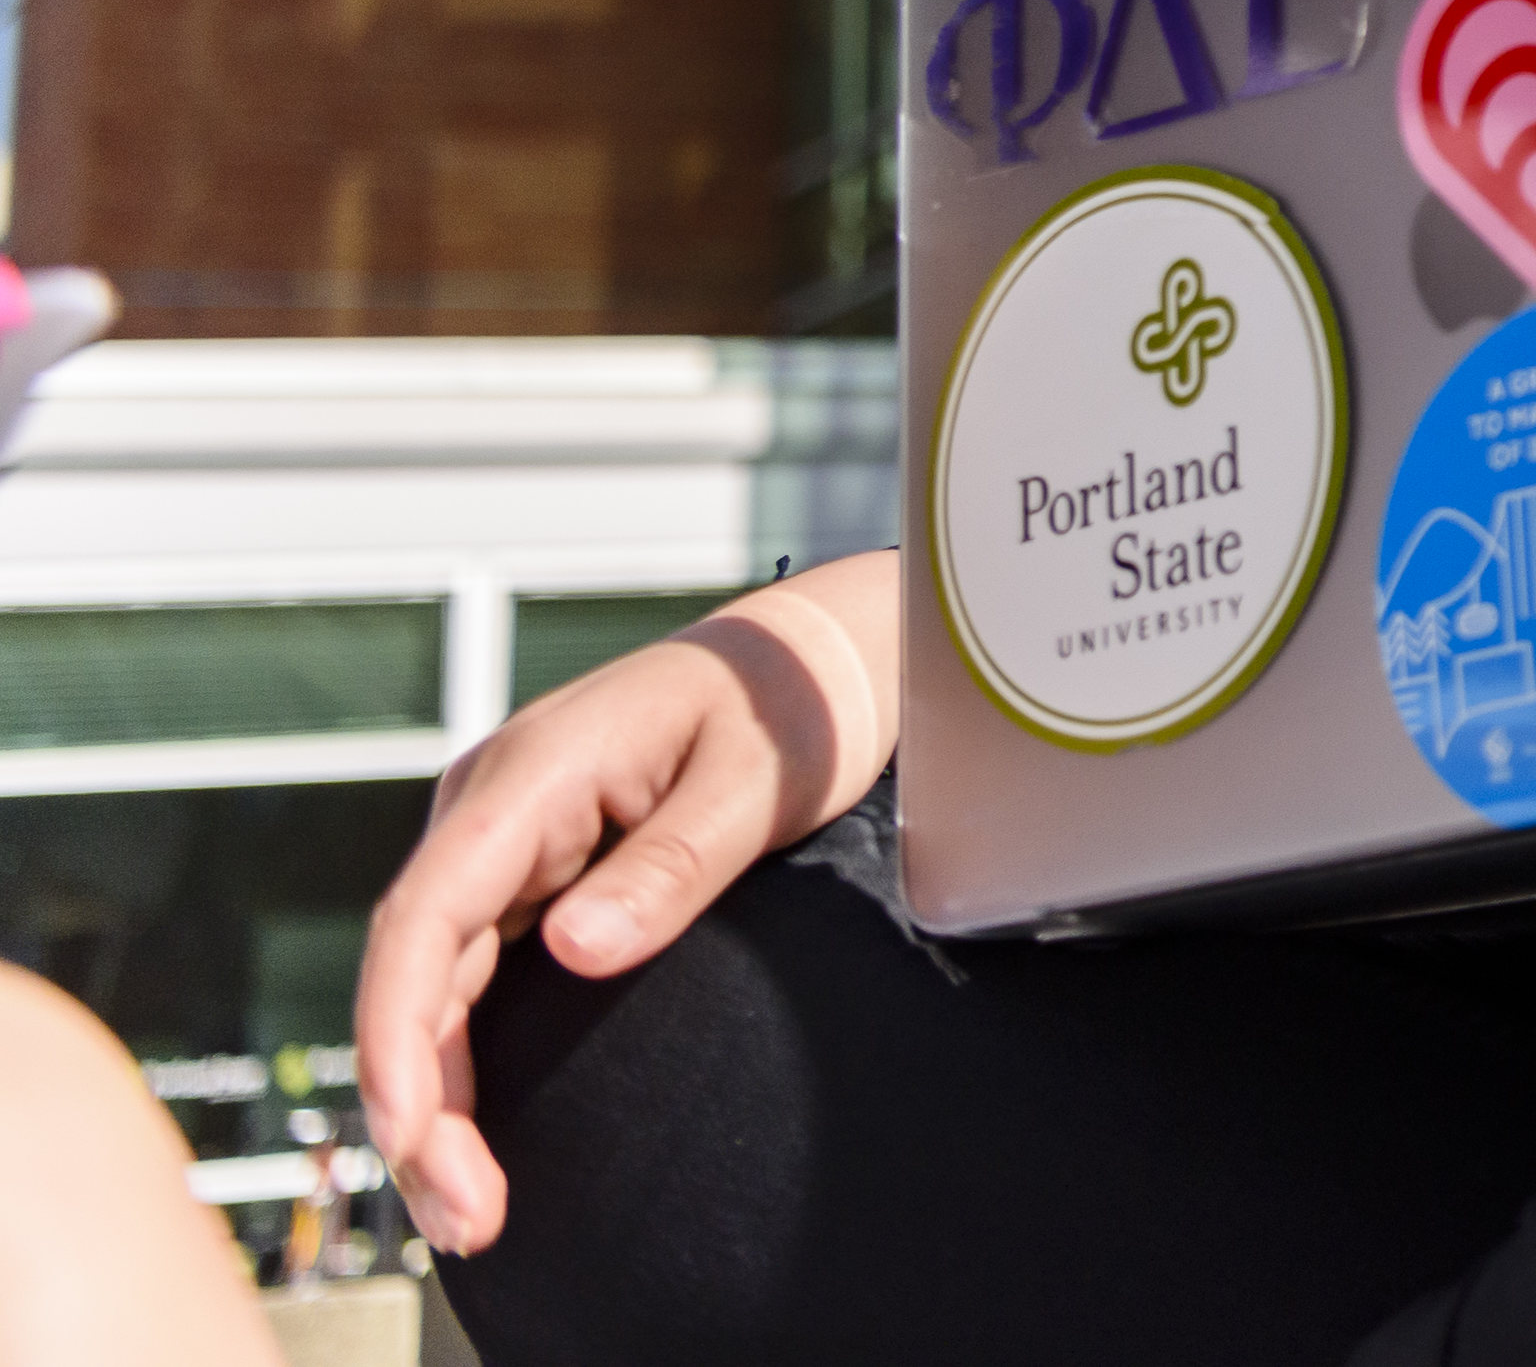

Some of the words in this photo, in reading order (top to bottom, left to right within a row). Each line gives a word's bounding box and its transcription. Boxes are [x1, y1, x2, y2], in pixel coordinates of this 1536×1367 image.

[1486, 377, 1507, 403] A
[1467, 409, 1504, 441] TO
[1486, 438, 1523, 472] OF
[1017, 425, 1243, 544] Portland
[1110, 526, 1244, 600] State
[1057, 595, 1243, 658] UNIVERSITY
